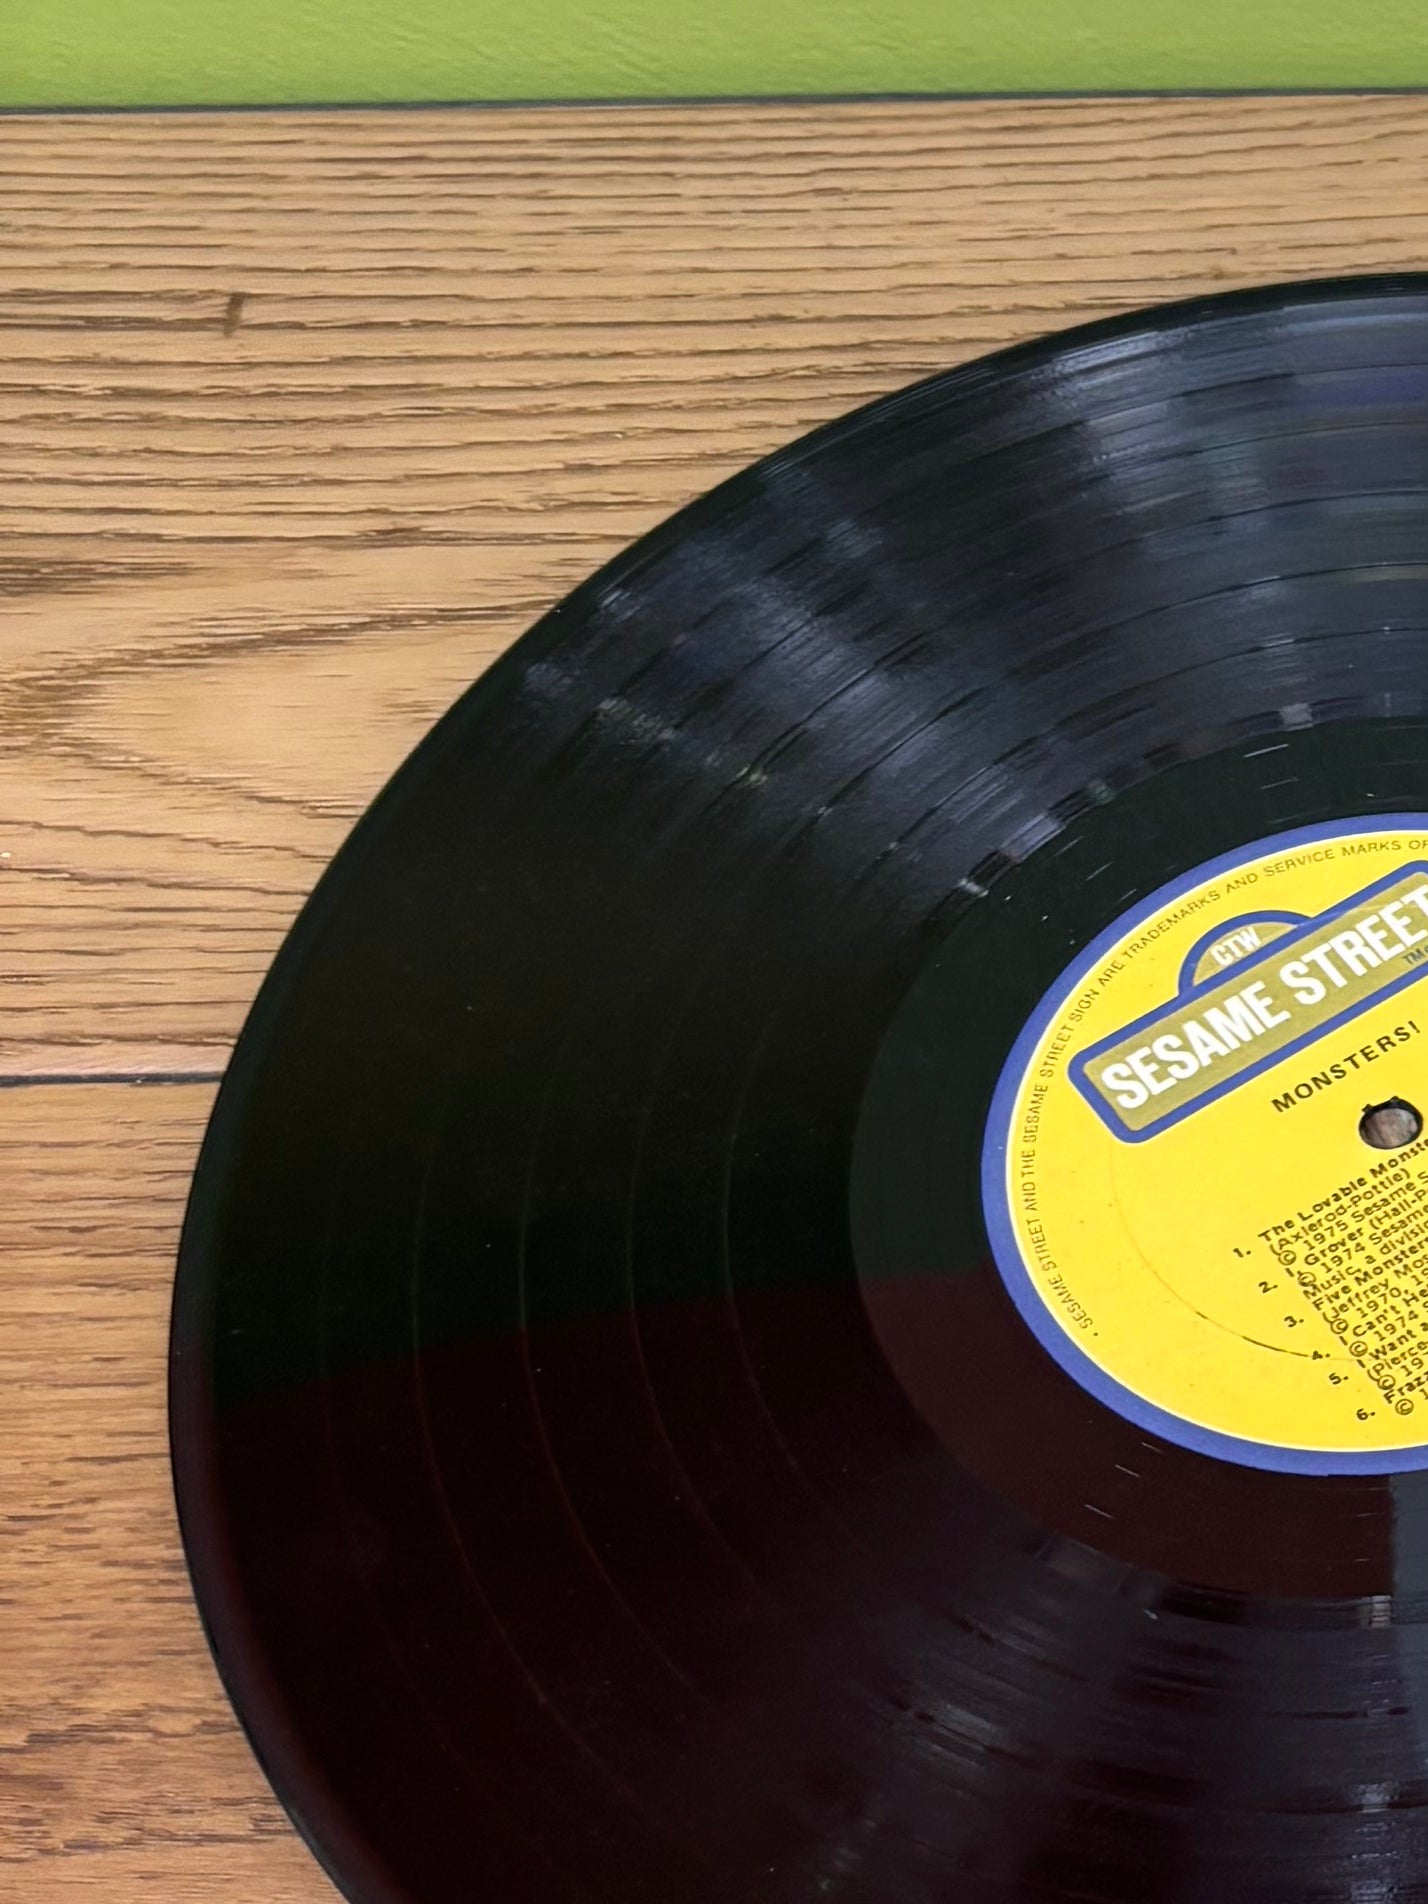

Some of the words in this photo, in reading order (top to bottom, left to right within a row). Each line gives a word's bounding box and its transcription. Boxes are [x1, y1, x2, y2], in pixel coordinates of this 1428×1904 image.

[1263, 849, 1335, 877] SERVICE
[1342, 841, 1400, 857] MARKS
[1226, 872, 1259, 893] AND
[1123, 890, 1220, 959] TRADEMARKS
[1211, 927, 1262, 966] CTW
[1402, 949, 1426, 965] TM
[1099, 959, 1124, 987] ARE
[1069, 989, 1100, 1022] SIGN
[1101, 981, 1290, 1110] SESAME
[1271, 1020, 1421, 1113] MONSTERS!
[1021, 1150, 1035, 1179] THE
[1022, 1182, 1036, 1211] AND
[1233, 1248, 1251, 1258] 1.
[1258, 1219, 1295, 1242] The
[1297, 1177, 1367, 1221] Lovable
[1258, 1282, 1278, 1294] 2.
[1304, 1227, 1364, 1265] Grover
[1284, 1316, 1304, 1327] 3.
[1312, 1285, 1350, 1310] Five
[1312, 1351, 1330, 1360] 4.
[1339, 1336, 1348, 1345] I
[1352, 1305, 1401, 1337] Can't
[1329, 1372, 1349, 1384] 5.
[1357, 1359, 1366, 1368] I
[1368, 1329, 1417, 1360] Want
[1356, 1408, 1376, 1420] 6.
